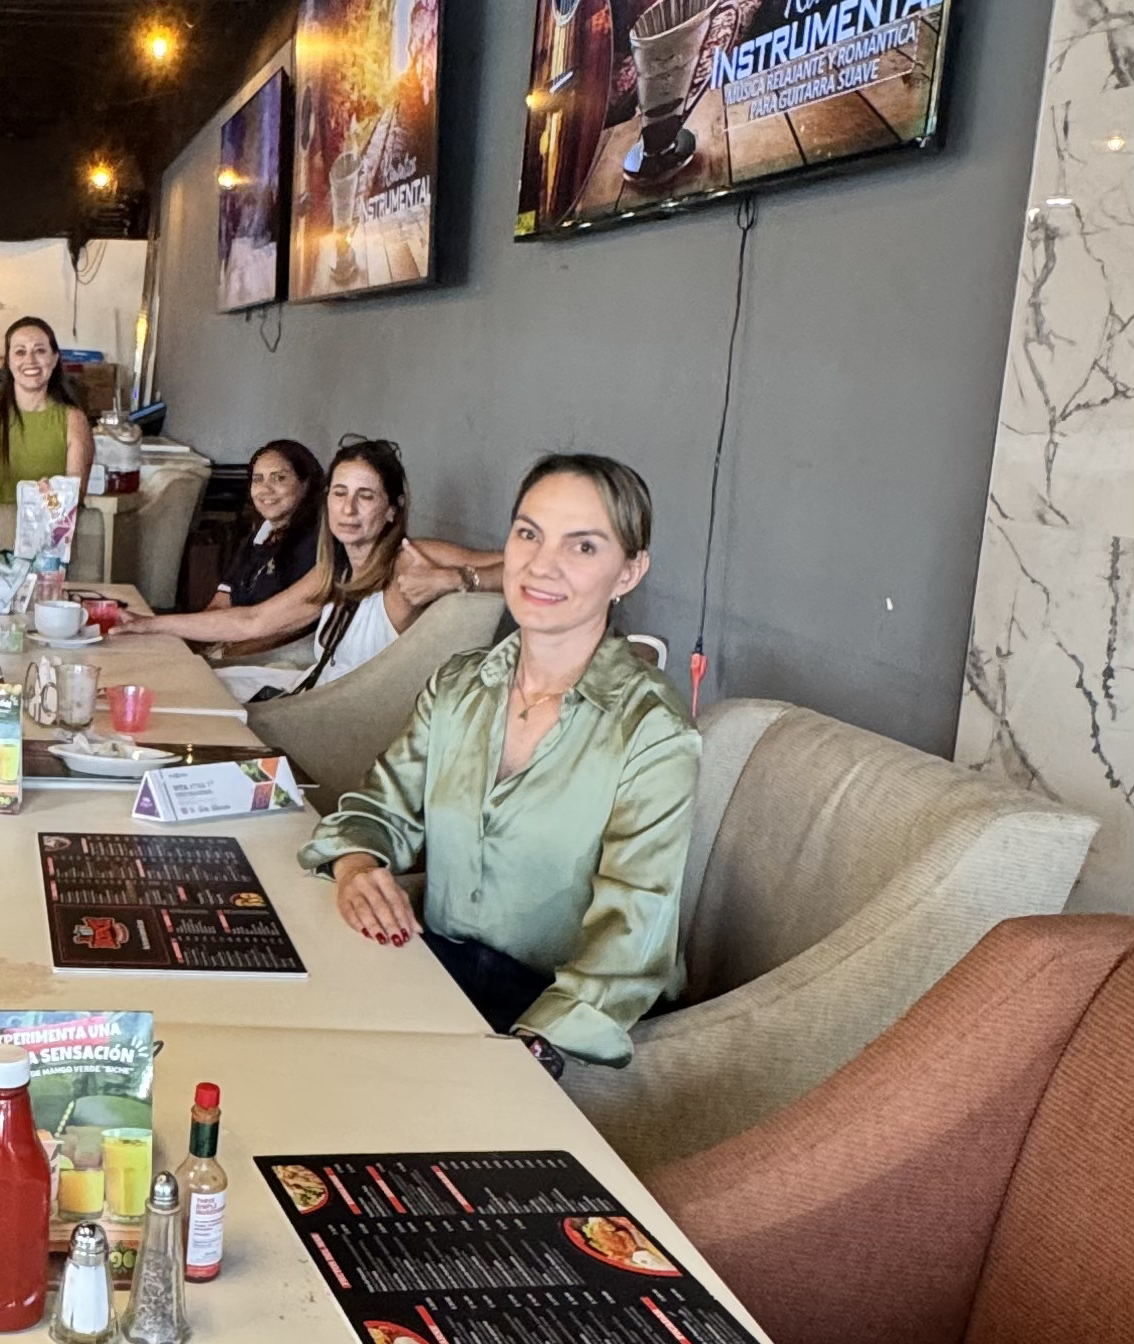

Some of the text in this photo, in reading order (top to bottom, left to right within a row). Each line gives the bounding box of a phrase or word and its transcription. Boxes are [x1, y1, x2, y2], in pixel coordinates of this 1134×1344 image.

[766, 58, 824, 92] RELAJANTE
[827, 53, 836, 69] Y
[750, 58, 881, 120] PARA GUITARRA SUAVE
[88, 1022, 121, 1039] UNA
[40, 1043, 134, 1064] SENSACIÓN
[42, 1066, 73, 1076] MANGO
[75, 1064, 101, 1073] VERDE
